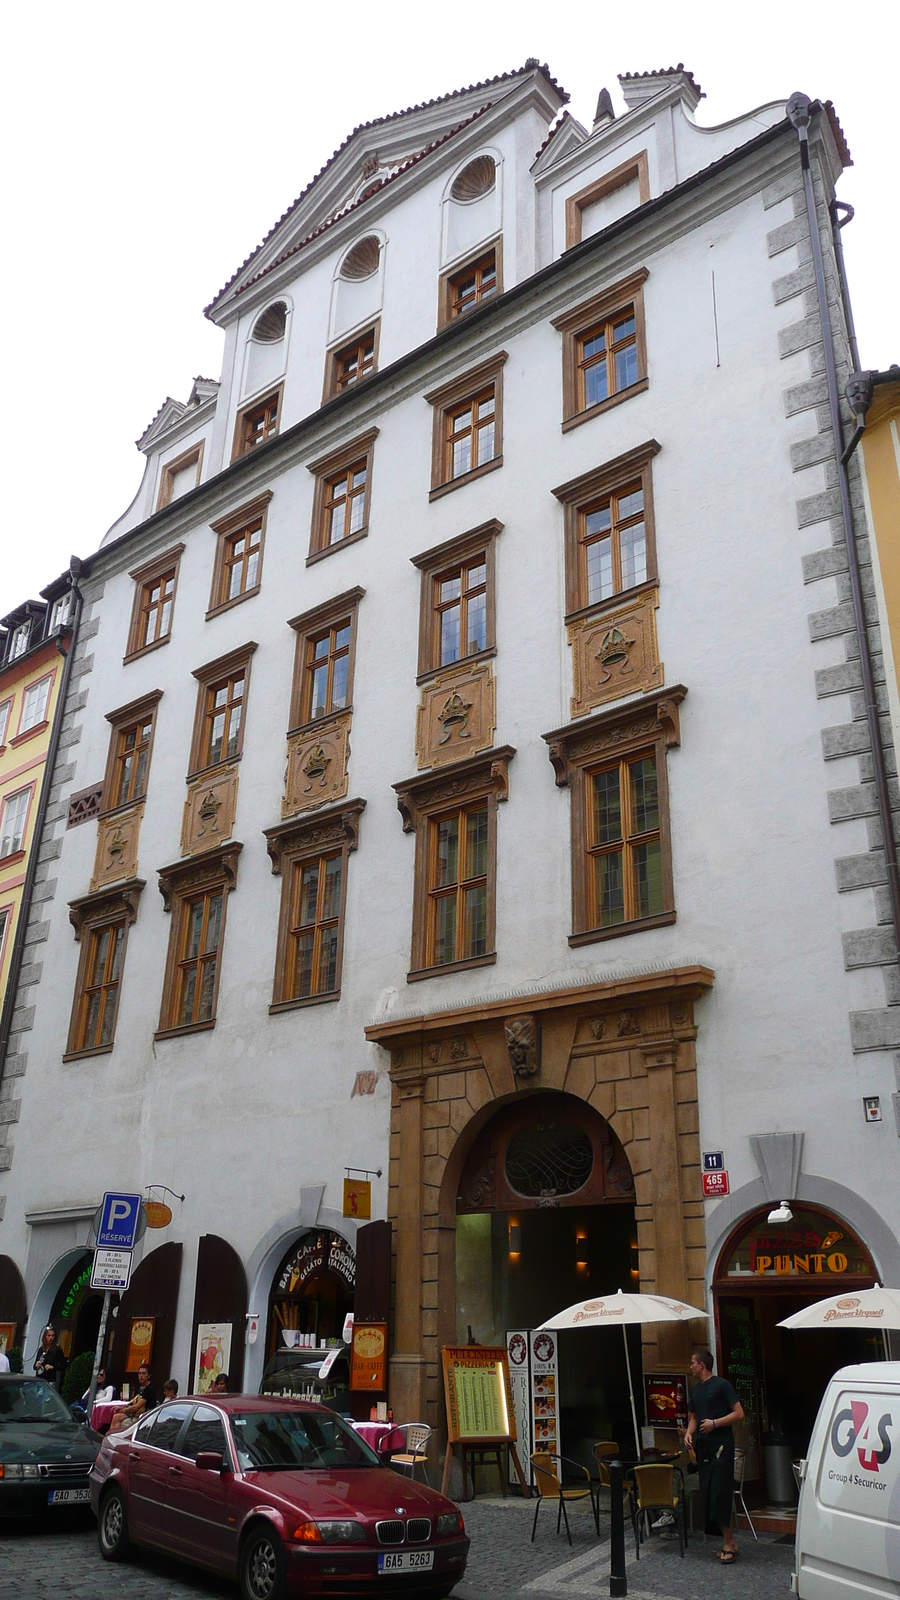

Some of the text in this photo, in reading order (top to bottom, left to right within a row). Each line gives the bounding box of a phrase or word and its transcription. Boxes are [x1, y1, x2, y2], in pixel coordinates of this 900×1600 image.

[708, 1156, 717, 1167] 11
[706, 1174, 723, 1185] 465
[100, 1232, 132, 1243] RÉSERVÉ
[300, 1258, 353, 1282] GELATO ITALIANO
[756, 1252, 848, 1275] PUNTO
[279, 1263, 294, 1289] BAR
[62, 1263, 93, 1317] RISTORAN
[823, 1309, 884, 1322] Pilsner Urquell
[449, 1349, 507, 1360] PULCINELLA
[460, 1361, 490, 1369] PIZZERIA
[520, 1377, 529, 1483] RISTORANTE
[831, 1400, 893, 1473] G4S
[828, 1470, 887, 1491] Group 4 Securicor
[385, 1553, 430, 1568] 6A5 5263
